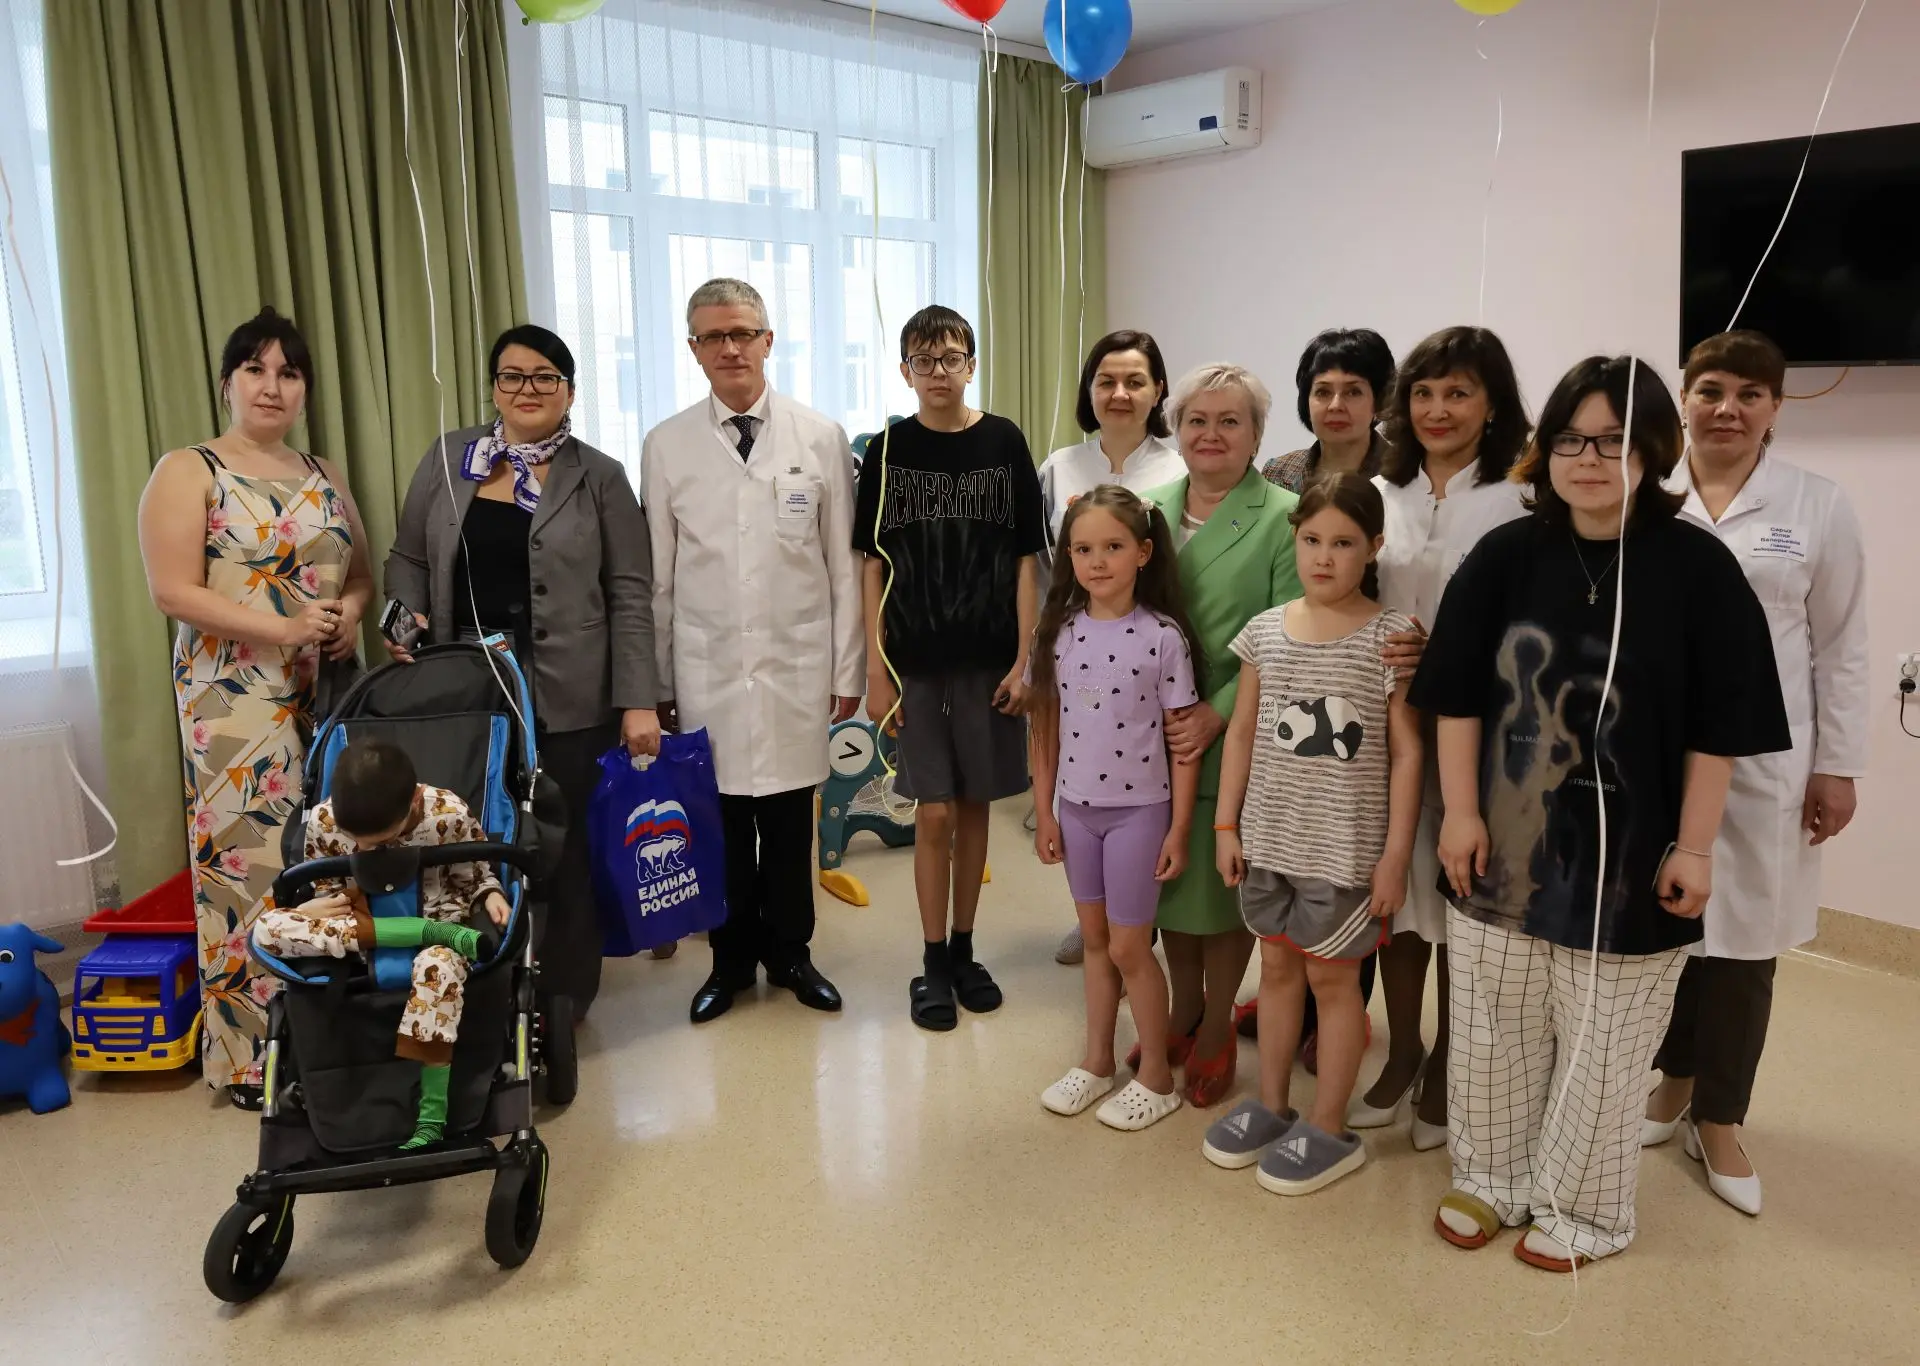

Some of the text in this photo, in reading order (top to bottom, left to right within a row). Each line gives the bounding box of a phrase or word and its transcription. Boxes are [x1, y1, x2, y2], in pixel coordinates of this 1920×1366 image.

[1261, 699, 1275, 707] eed
[1569, 778, 1616, 791] TRANERS
[638, 867, 697, 901] ЕДИНАЯ
[640, 882, 700, 917] РОССИЯ
